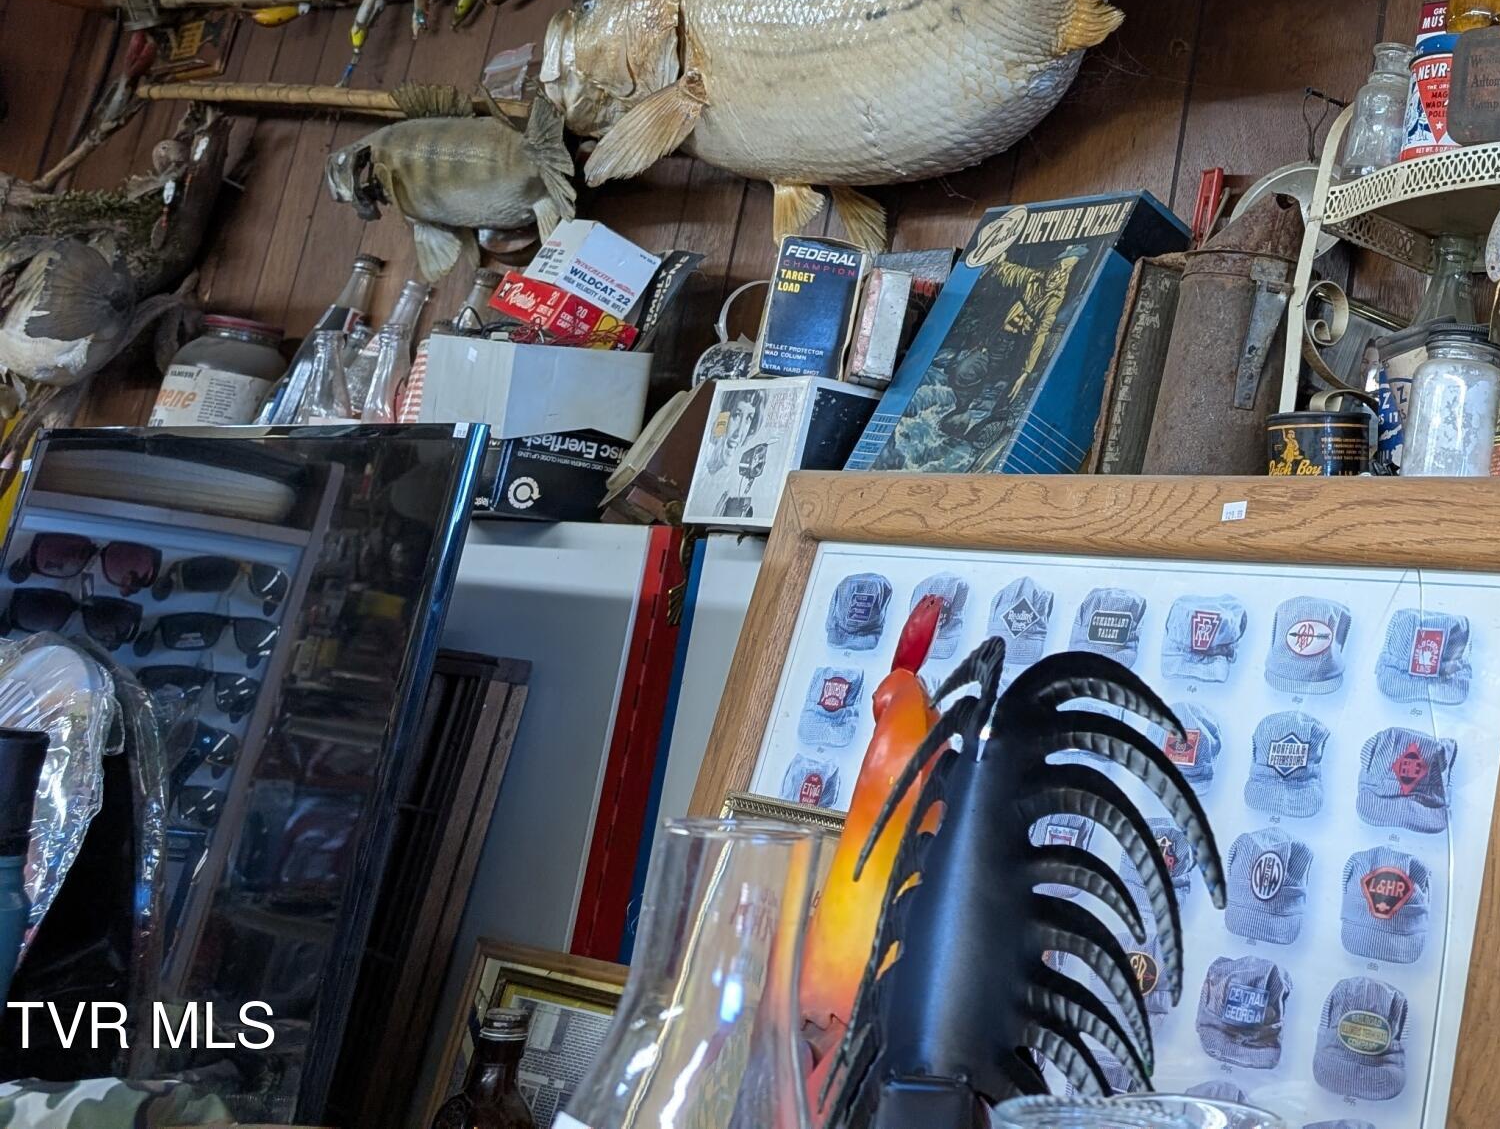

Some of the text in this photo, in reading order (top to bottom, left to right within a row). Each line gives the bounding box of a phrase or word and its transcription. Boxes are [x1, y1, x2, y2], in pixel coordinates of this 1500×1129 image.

[1422, 15, 1445, 29] MUS
[1417, 62, 1450, 82] NEVR-
[1431, 91, 1449, 99] MAG
[1427, 111, 1446, 119] POLI
[1018, 201, 1133, 245] PICTURE PUZZLE
[786, 245, 857, 266] FEDERAL
[783, 259, 856, 277] CHAMPION
[780, 269, 816, 283] TARGET
[563, 275, 625, 313] HIGH VELOCITY LONG RIFLE
[777, 281, 800, 294] LOAD
[765, 343, 824, 356] PELLET PROTECTOR
[780, 352, 807, 361] COLUMN
[783, 366, 801, 374] HARD
[803, 369, 820, 377] SHOT
[522, 435, 598, 459] Everflash
[1296, 460, 1322, 476] Boy
[1092, 616, 1130, 628] CUMBERLAND
[1097, 628, 1119, 639] VALLEY
[1272, 743, 1306, 755] NORFOLK &
[1369, 878, 1405, 898] L&HR
[1229, 987, 1265, 1008] CENTRAL
[1225, 1005, 1262, 1023] GEORGIA
[1347, 1037, 1377, 1050] COMPANY
